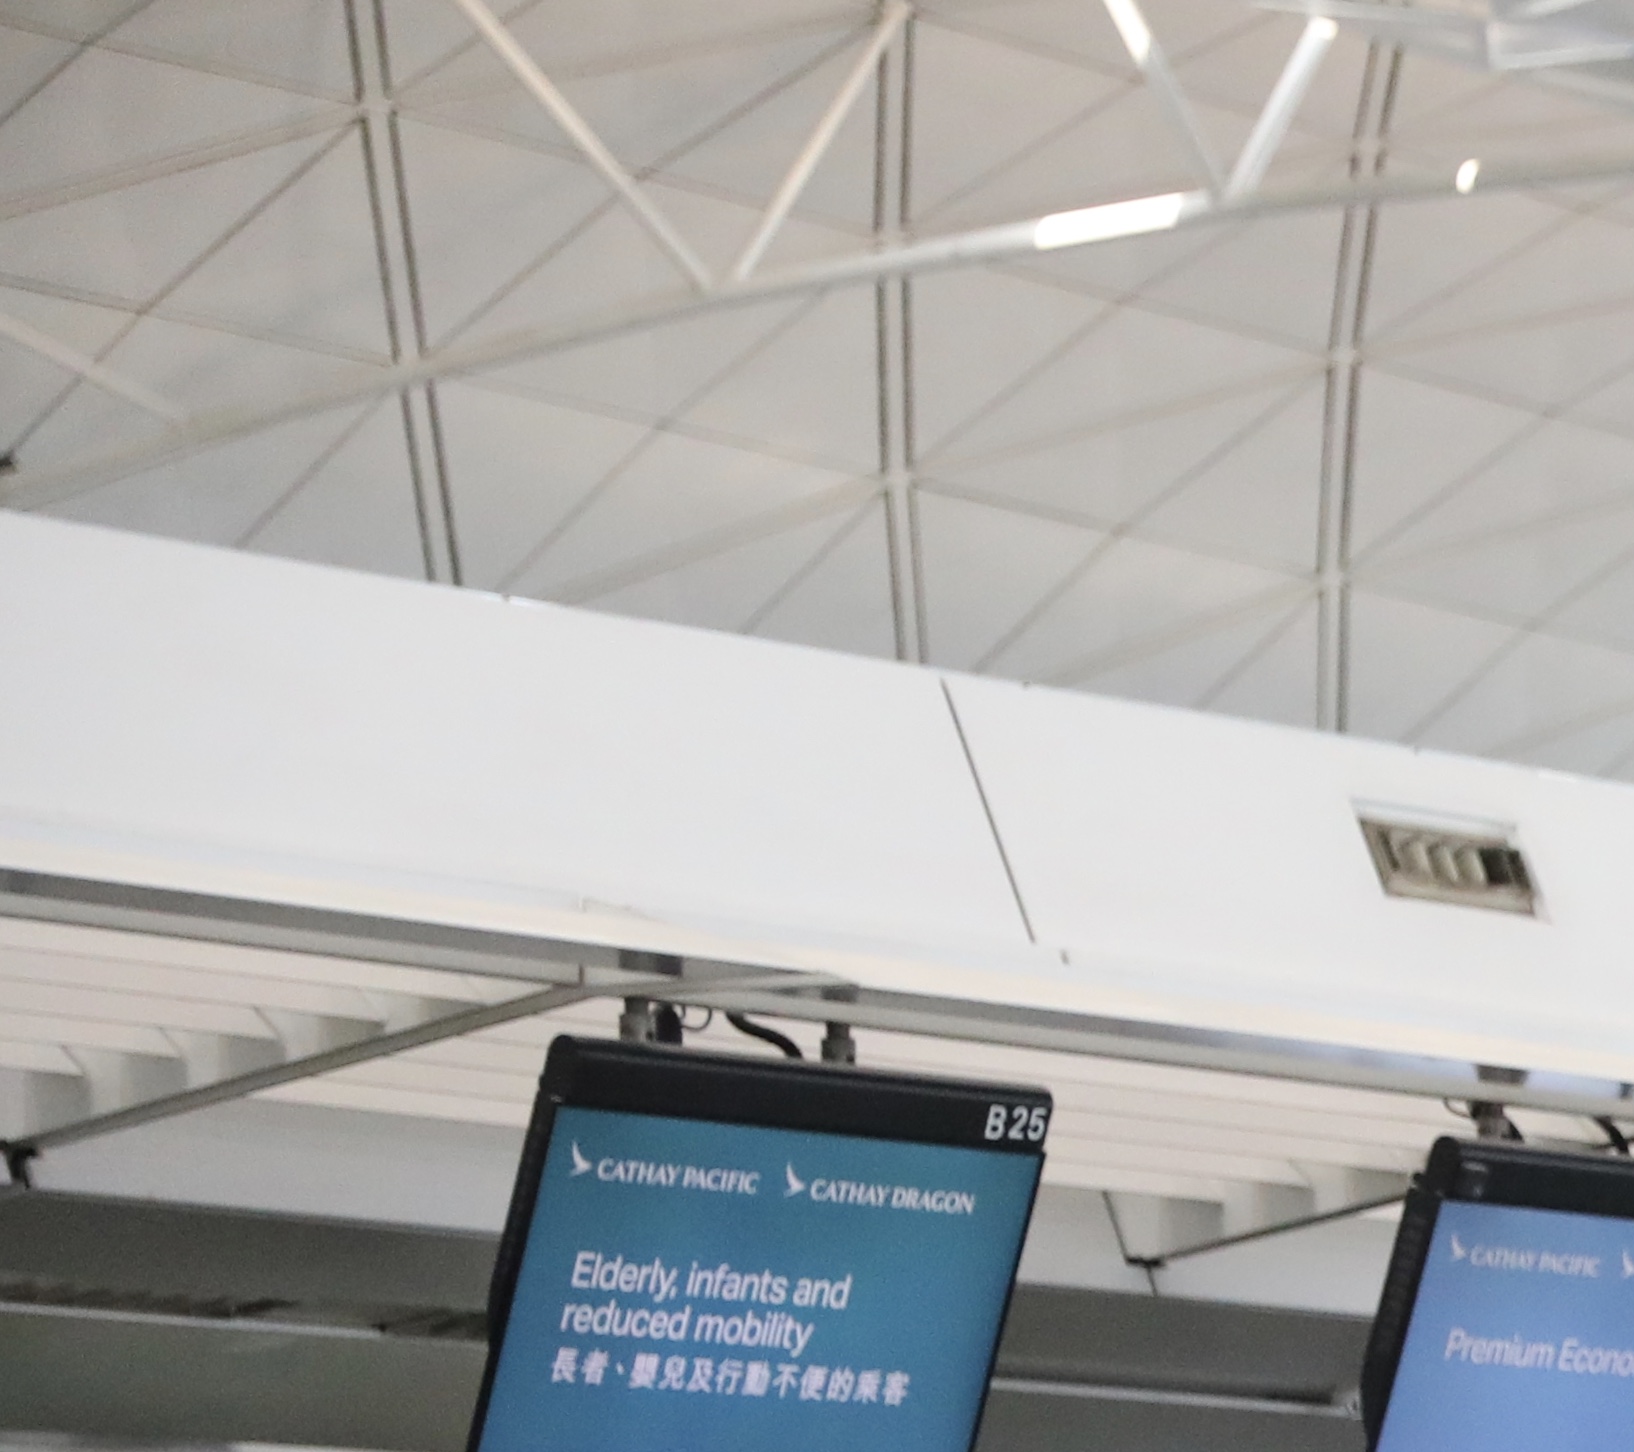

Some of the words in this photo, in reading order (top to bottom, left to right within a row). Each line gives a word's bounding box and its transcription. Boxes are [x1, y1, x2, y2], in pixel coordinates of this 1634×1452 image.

[597, 1157, 679, 1187] CATHAY
[681, 1164, 762, 1195] PACIFIC
[809, 1178, 890, 1208] CATHAY
[891, 1185, 976, 1215] DRAGON
[571, 1251, 679, 1302] Elderly,
[685, 1261, 788, 1303] infants
[792, 1274, 852, 1309] and
[1470, 1243, 1536, 1271] CATHAY
[1538, 1250, 1600, 1278] PACIFIC
[559, 1300, 691, 1341] reduced
[693, 1310, 814, 1358] mobility
[1445, 1328, 1555, 1370] Premium
